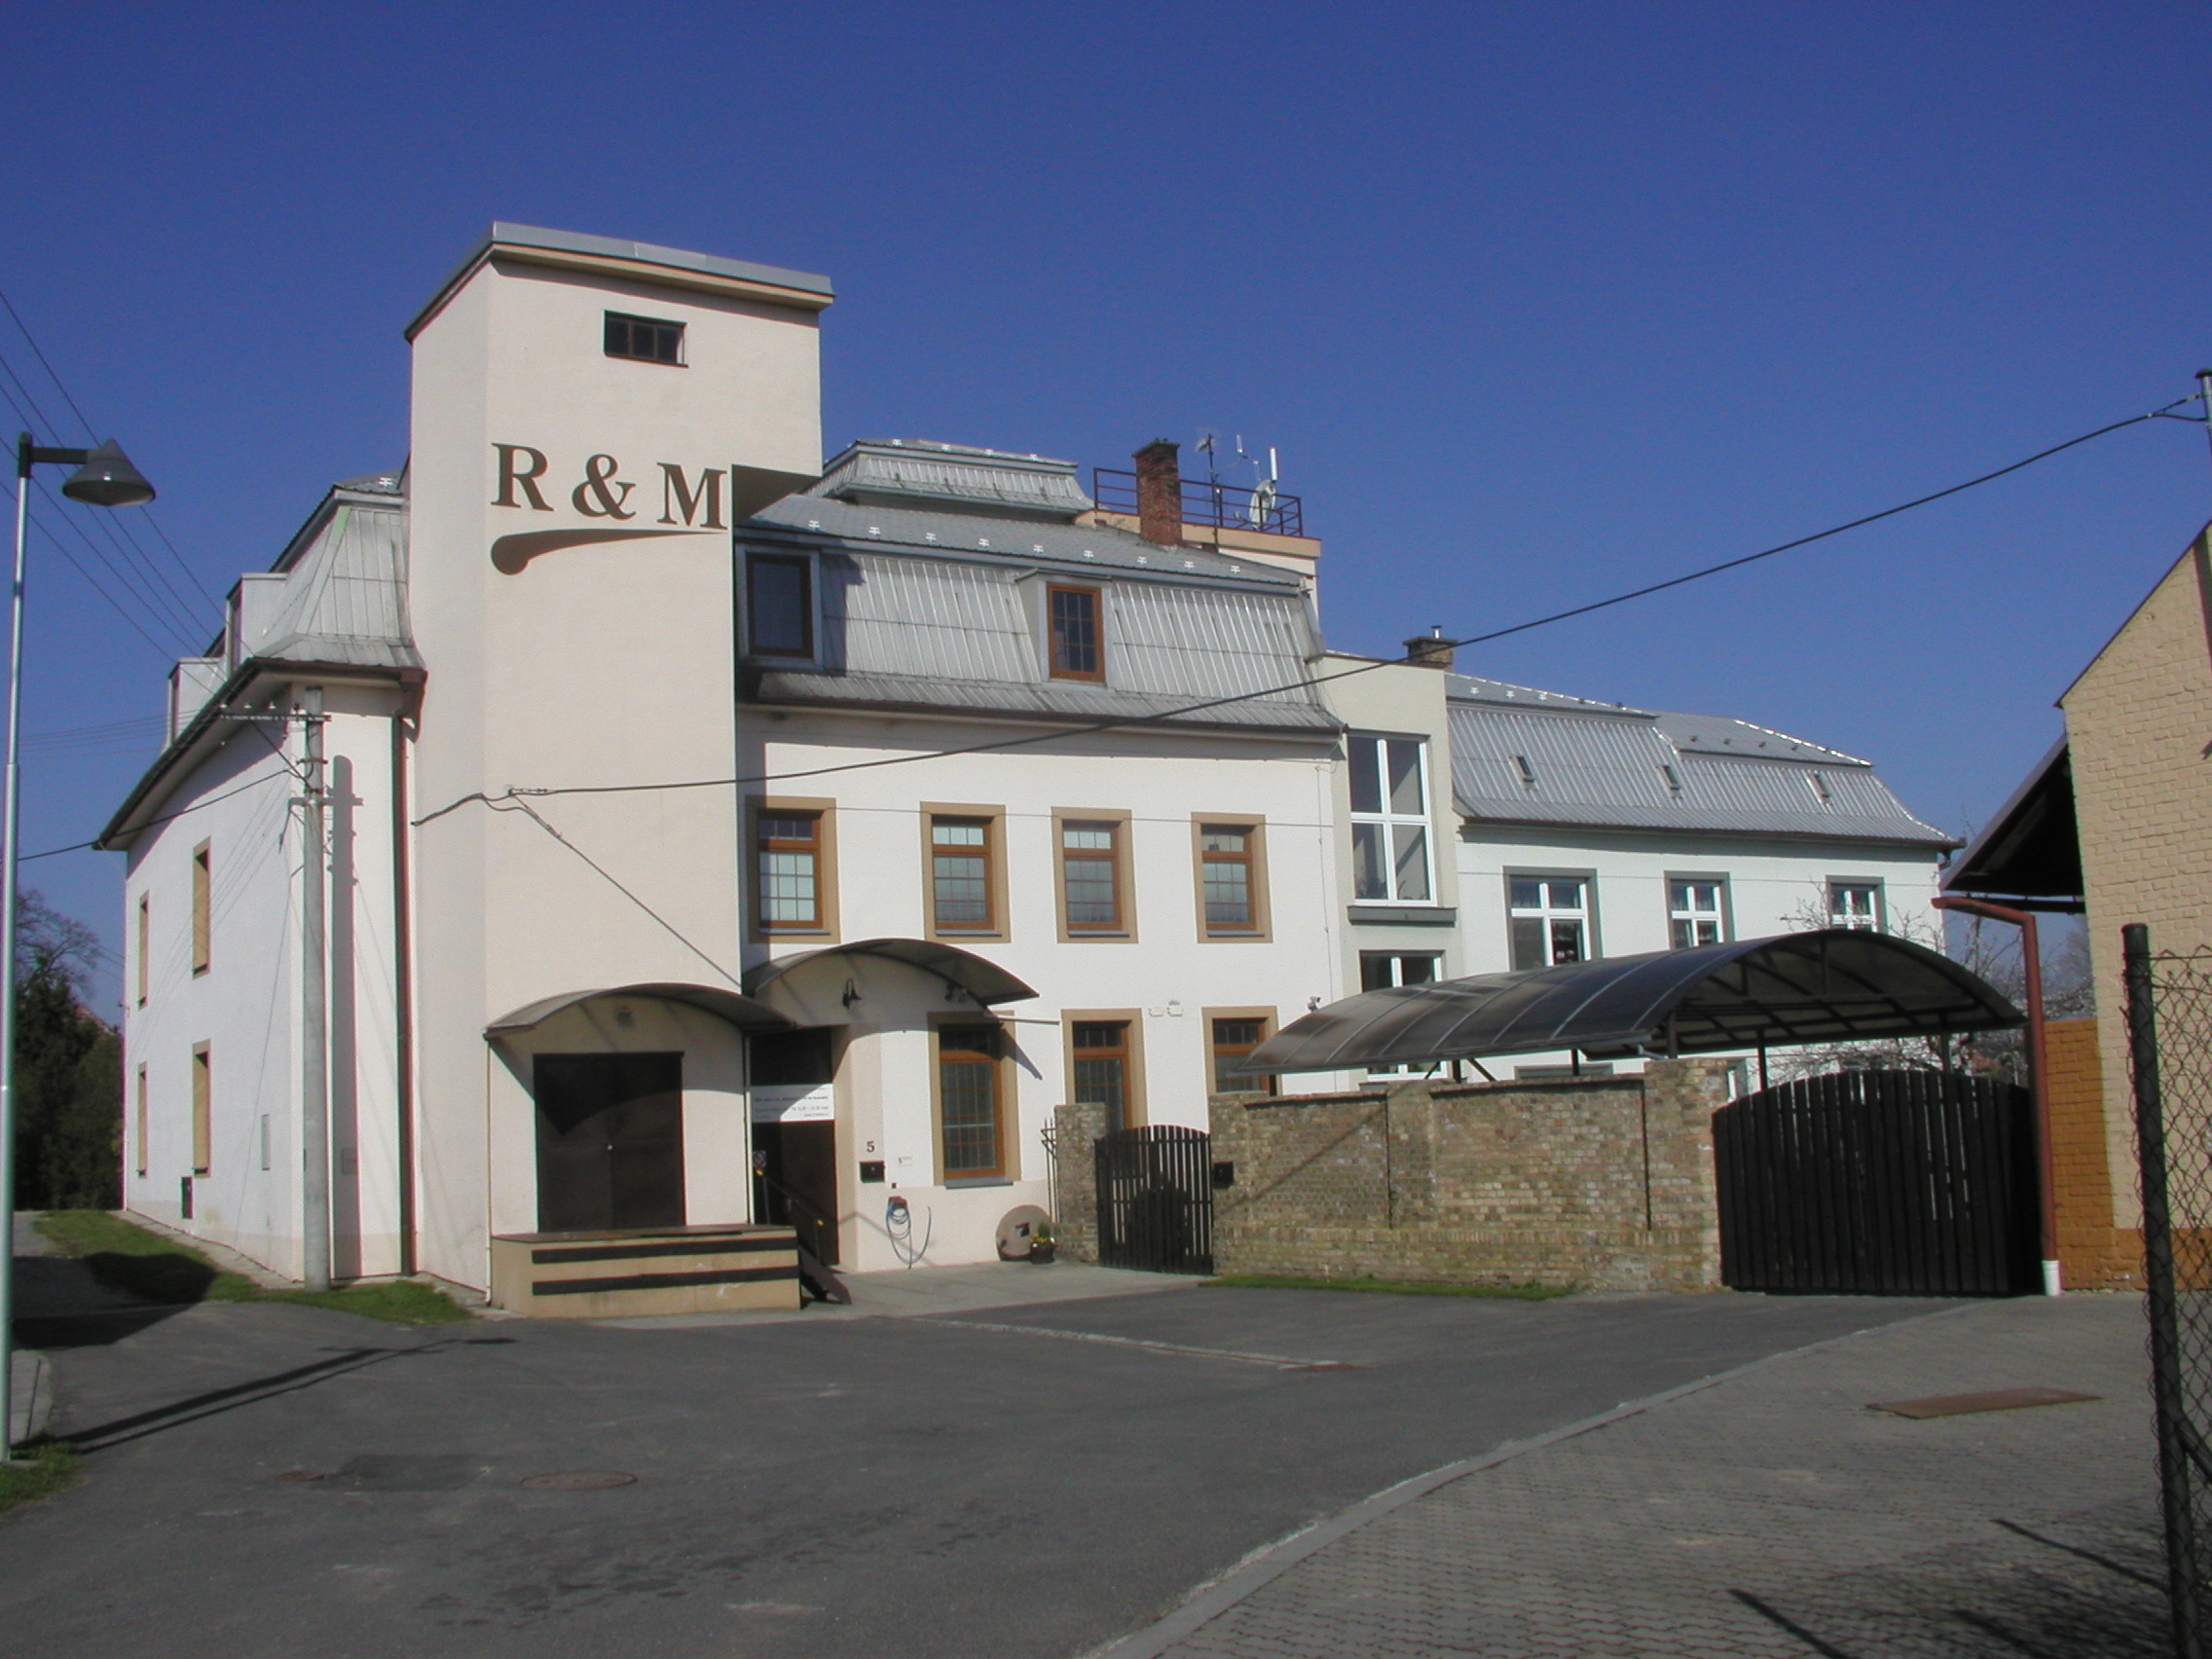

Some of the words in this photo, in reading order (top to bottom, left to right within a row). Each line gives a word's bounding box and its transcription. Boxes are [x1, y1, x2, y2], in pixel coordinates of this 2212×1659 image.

[491, 443, 554, 512] R
[571, 454, 637, 520] &
[656, 462, 728, 530] M
[866, 1140, 875, 1153] 5
